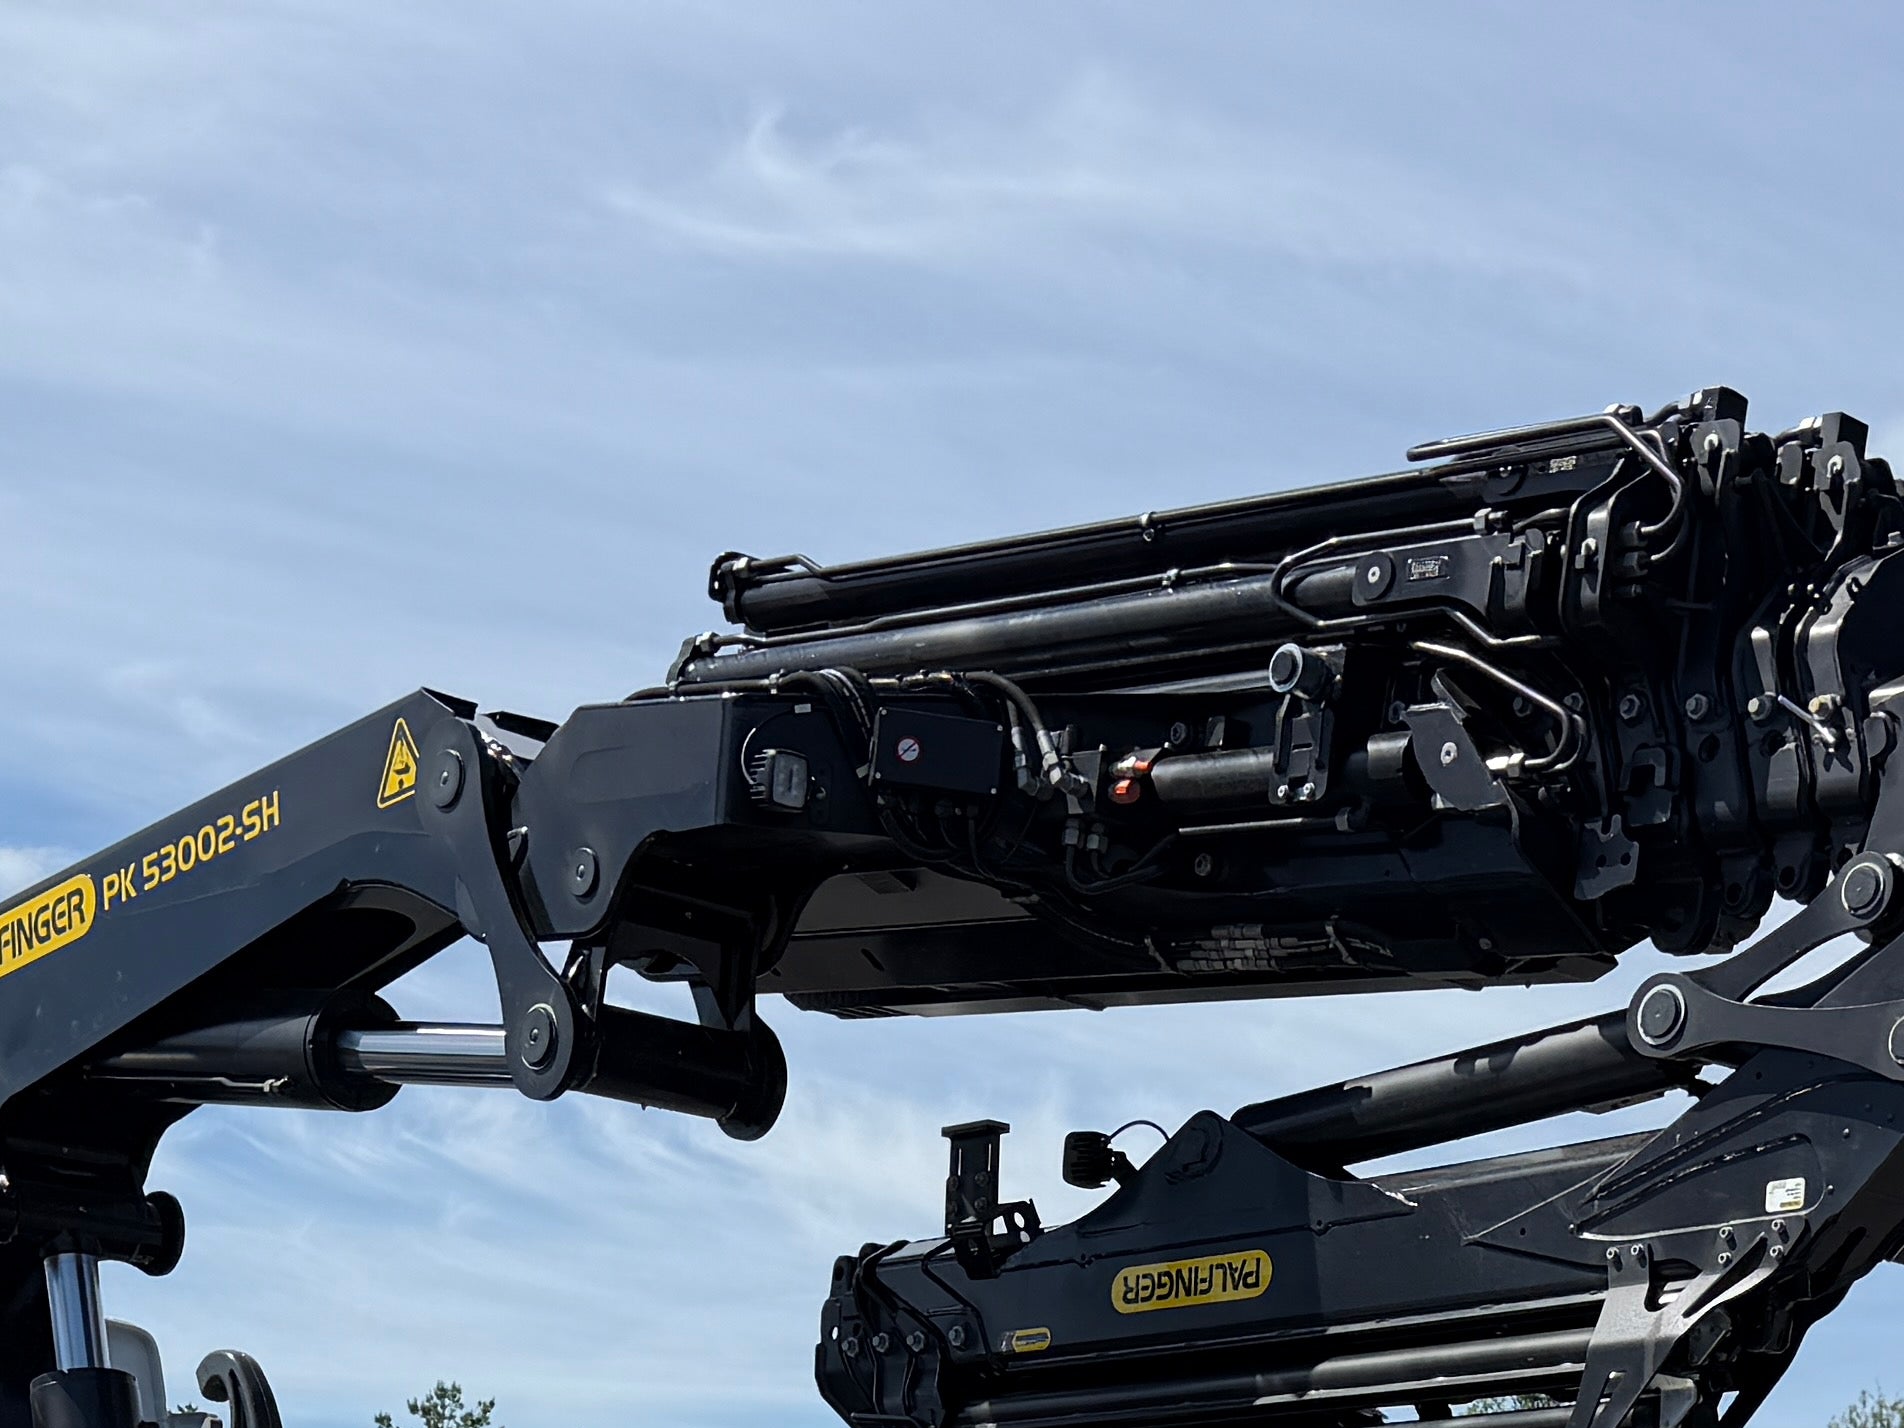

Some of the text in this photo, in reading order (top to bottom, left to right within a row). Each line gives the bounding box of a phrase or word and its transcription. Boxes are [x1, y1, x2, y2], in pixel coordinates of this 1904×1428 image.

[103, 862, 137, 911] PK
[142, 790, 281, 891] 53002-SH
[1122, 1257, 1262, 1305] PALFINGER
